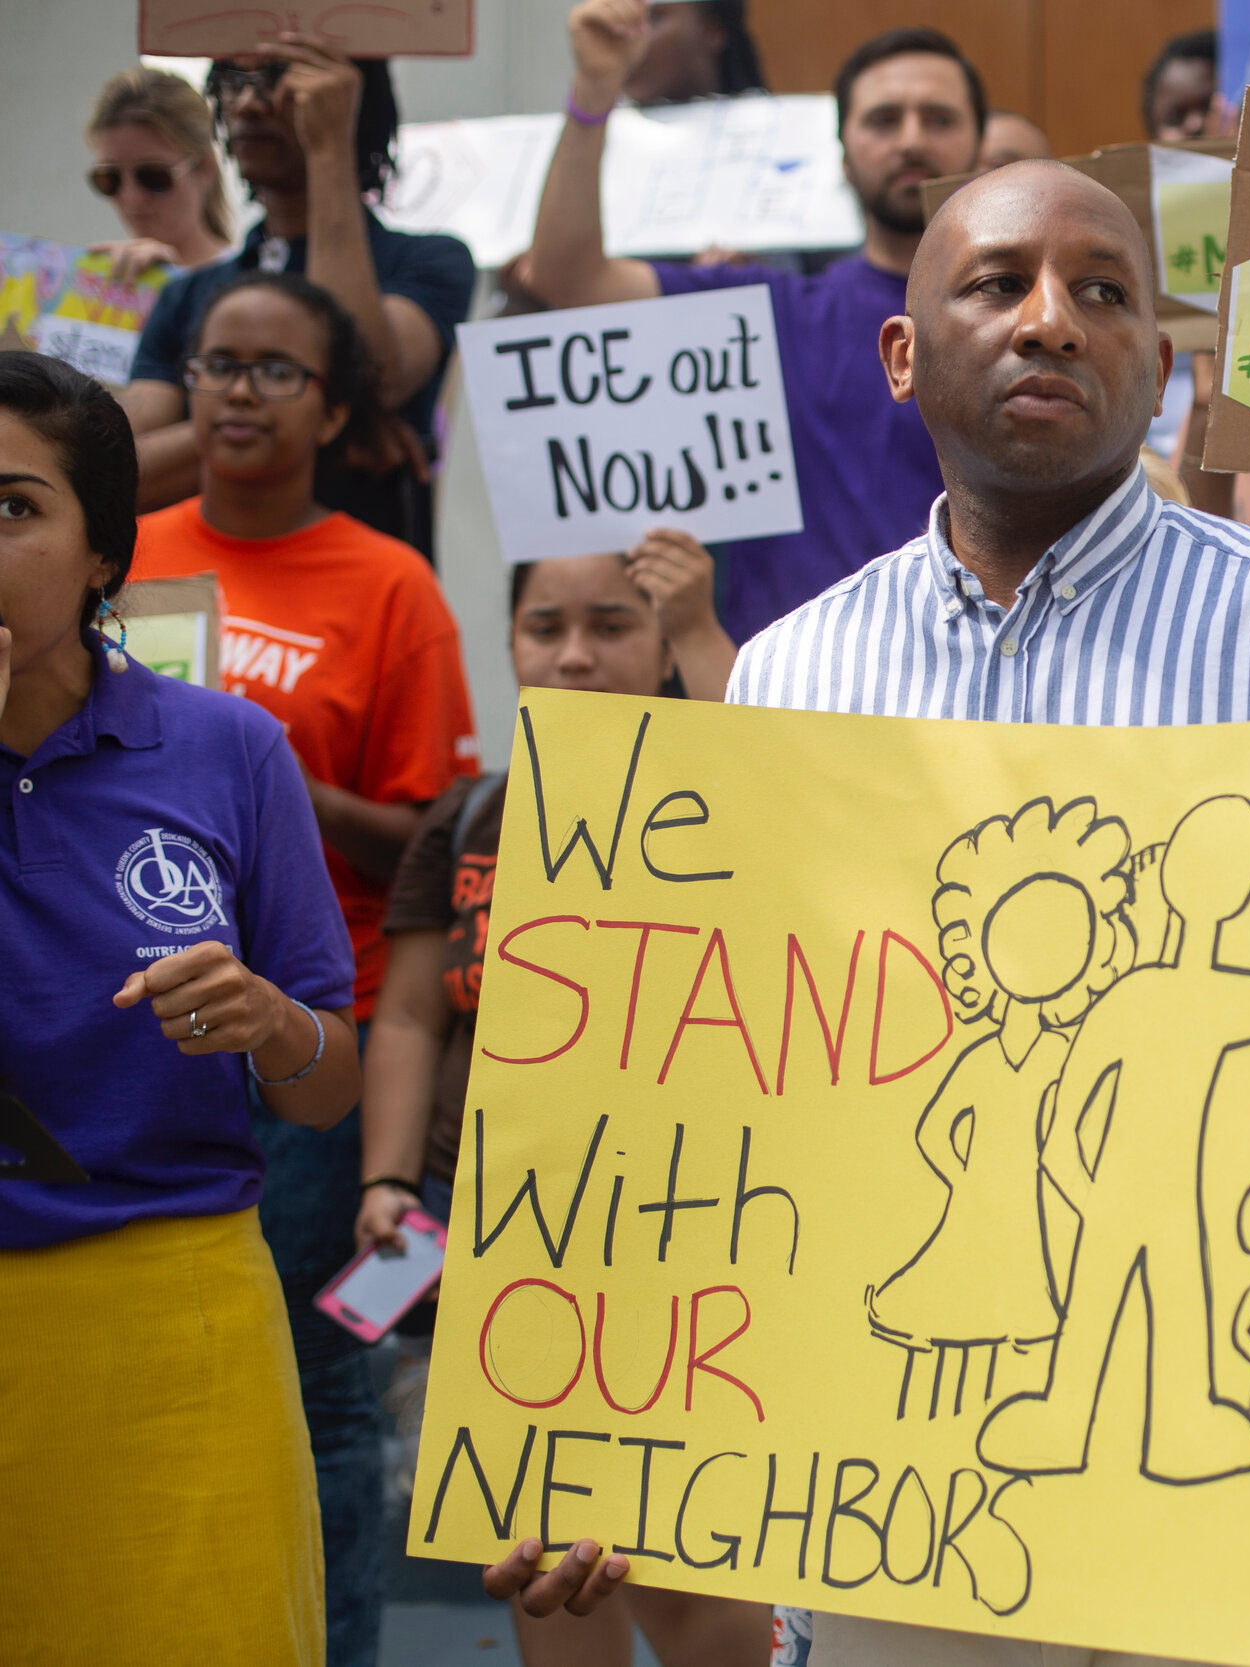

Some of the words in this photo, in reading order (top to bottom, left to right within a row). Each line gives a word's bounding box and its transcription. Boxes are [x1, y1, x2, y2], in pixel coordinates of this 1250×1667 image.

[495, 328, 651, 411] ICE
[669, 315, 760, 394] out
[519, 705, 735, 891] We
[480, 914, 955, 1097] STAND
[473, 1108, 800, 1275] With
[478, 1277, 766, 1422] OUR
[424, 1423, 1034, 1617] NEIGHBORS
